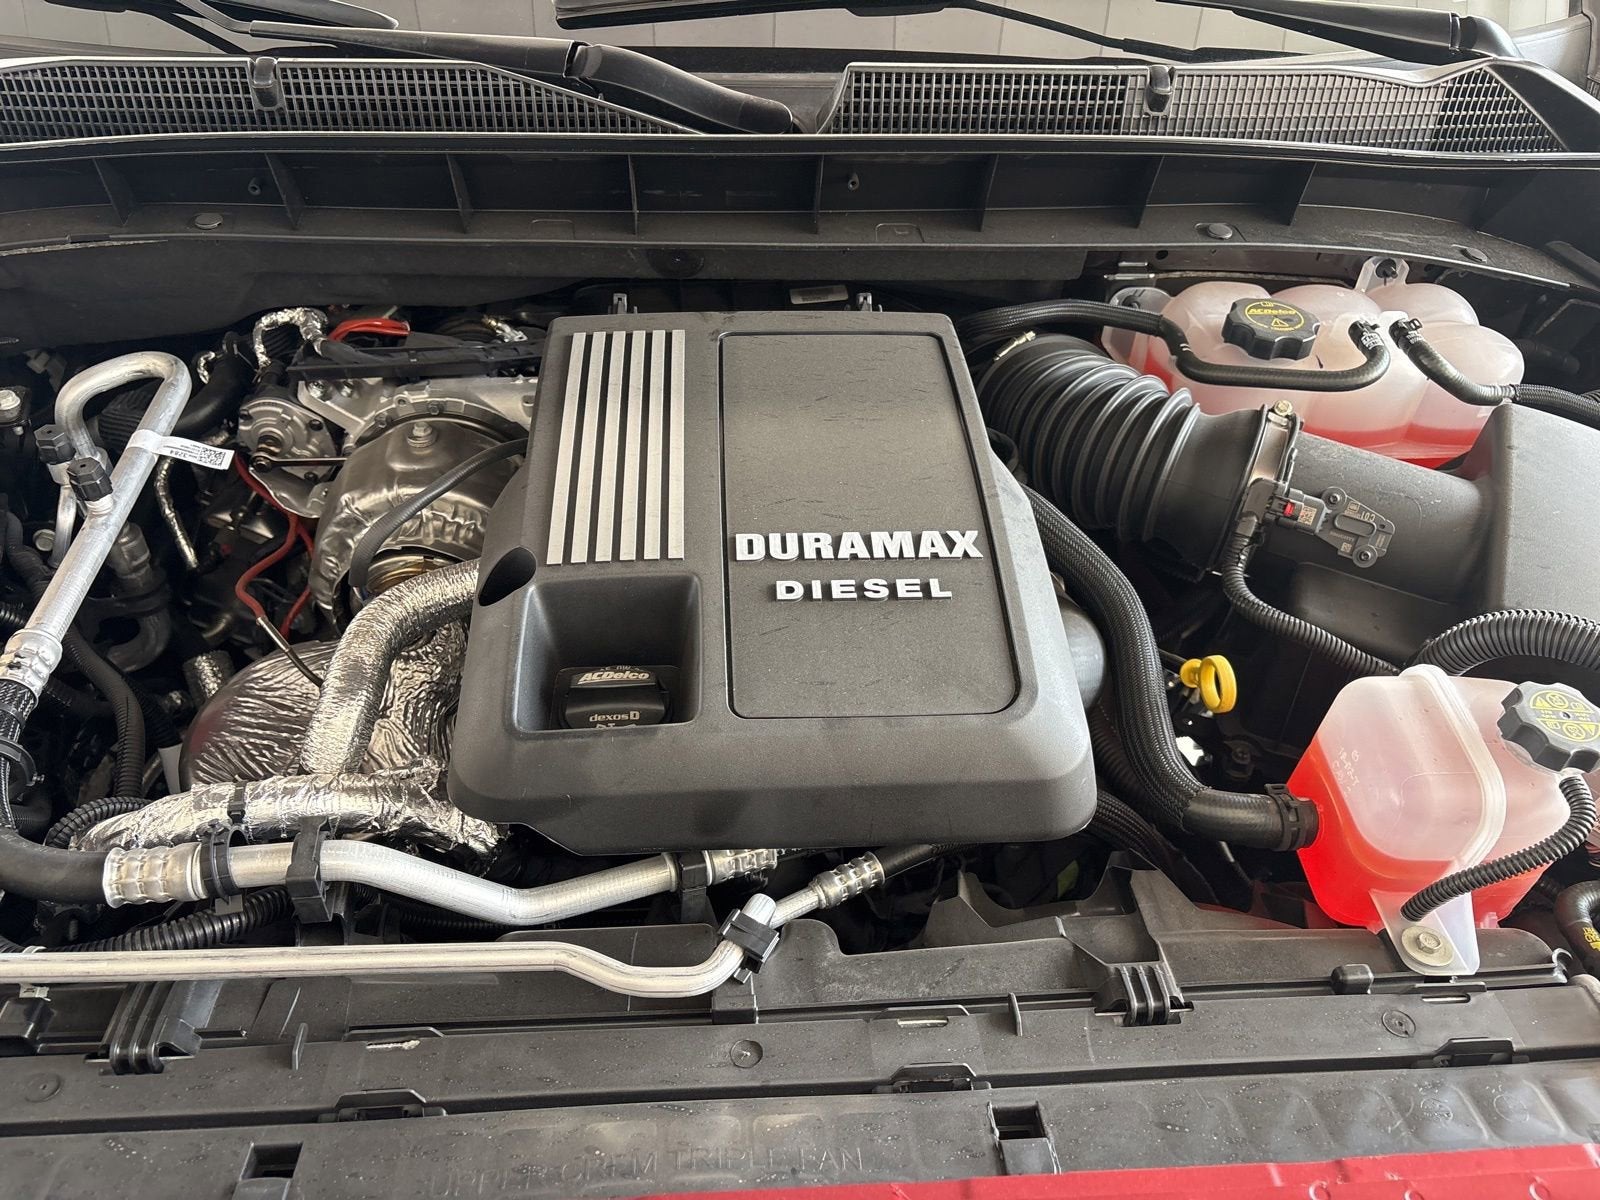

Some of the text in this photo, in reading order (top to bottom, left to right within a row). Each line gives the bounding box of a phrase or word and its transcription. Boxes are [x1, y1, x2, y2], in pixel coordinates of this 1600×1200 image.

[735, 530, 984, 561] DURAMAX
[776, 578, 953, 600] DIESEL
[578, 670, 650, 684] ACDelco
